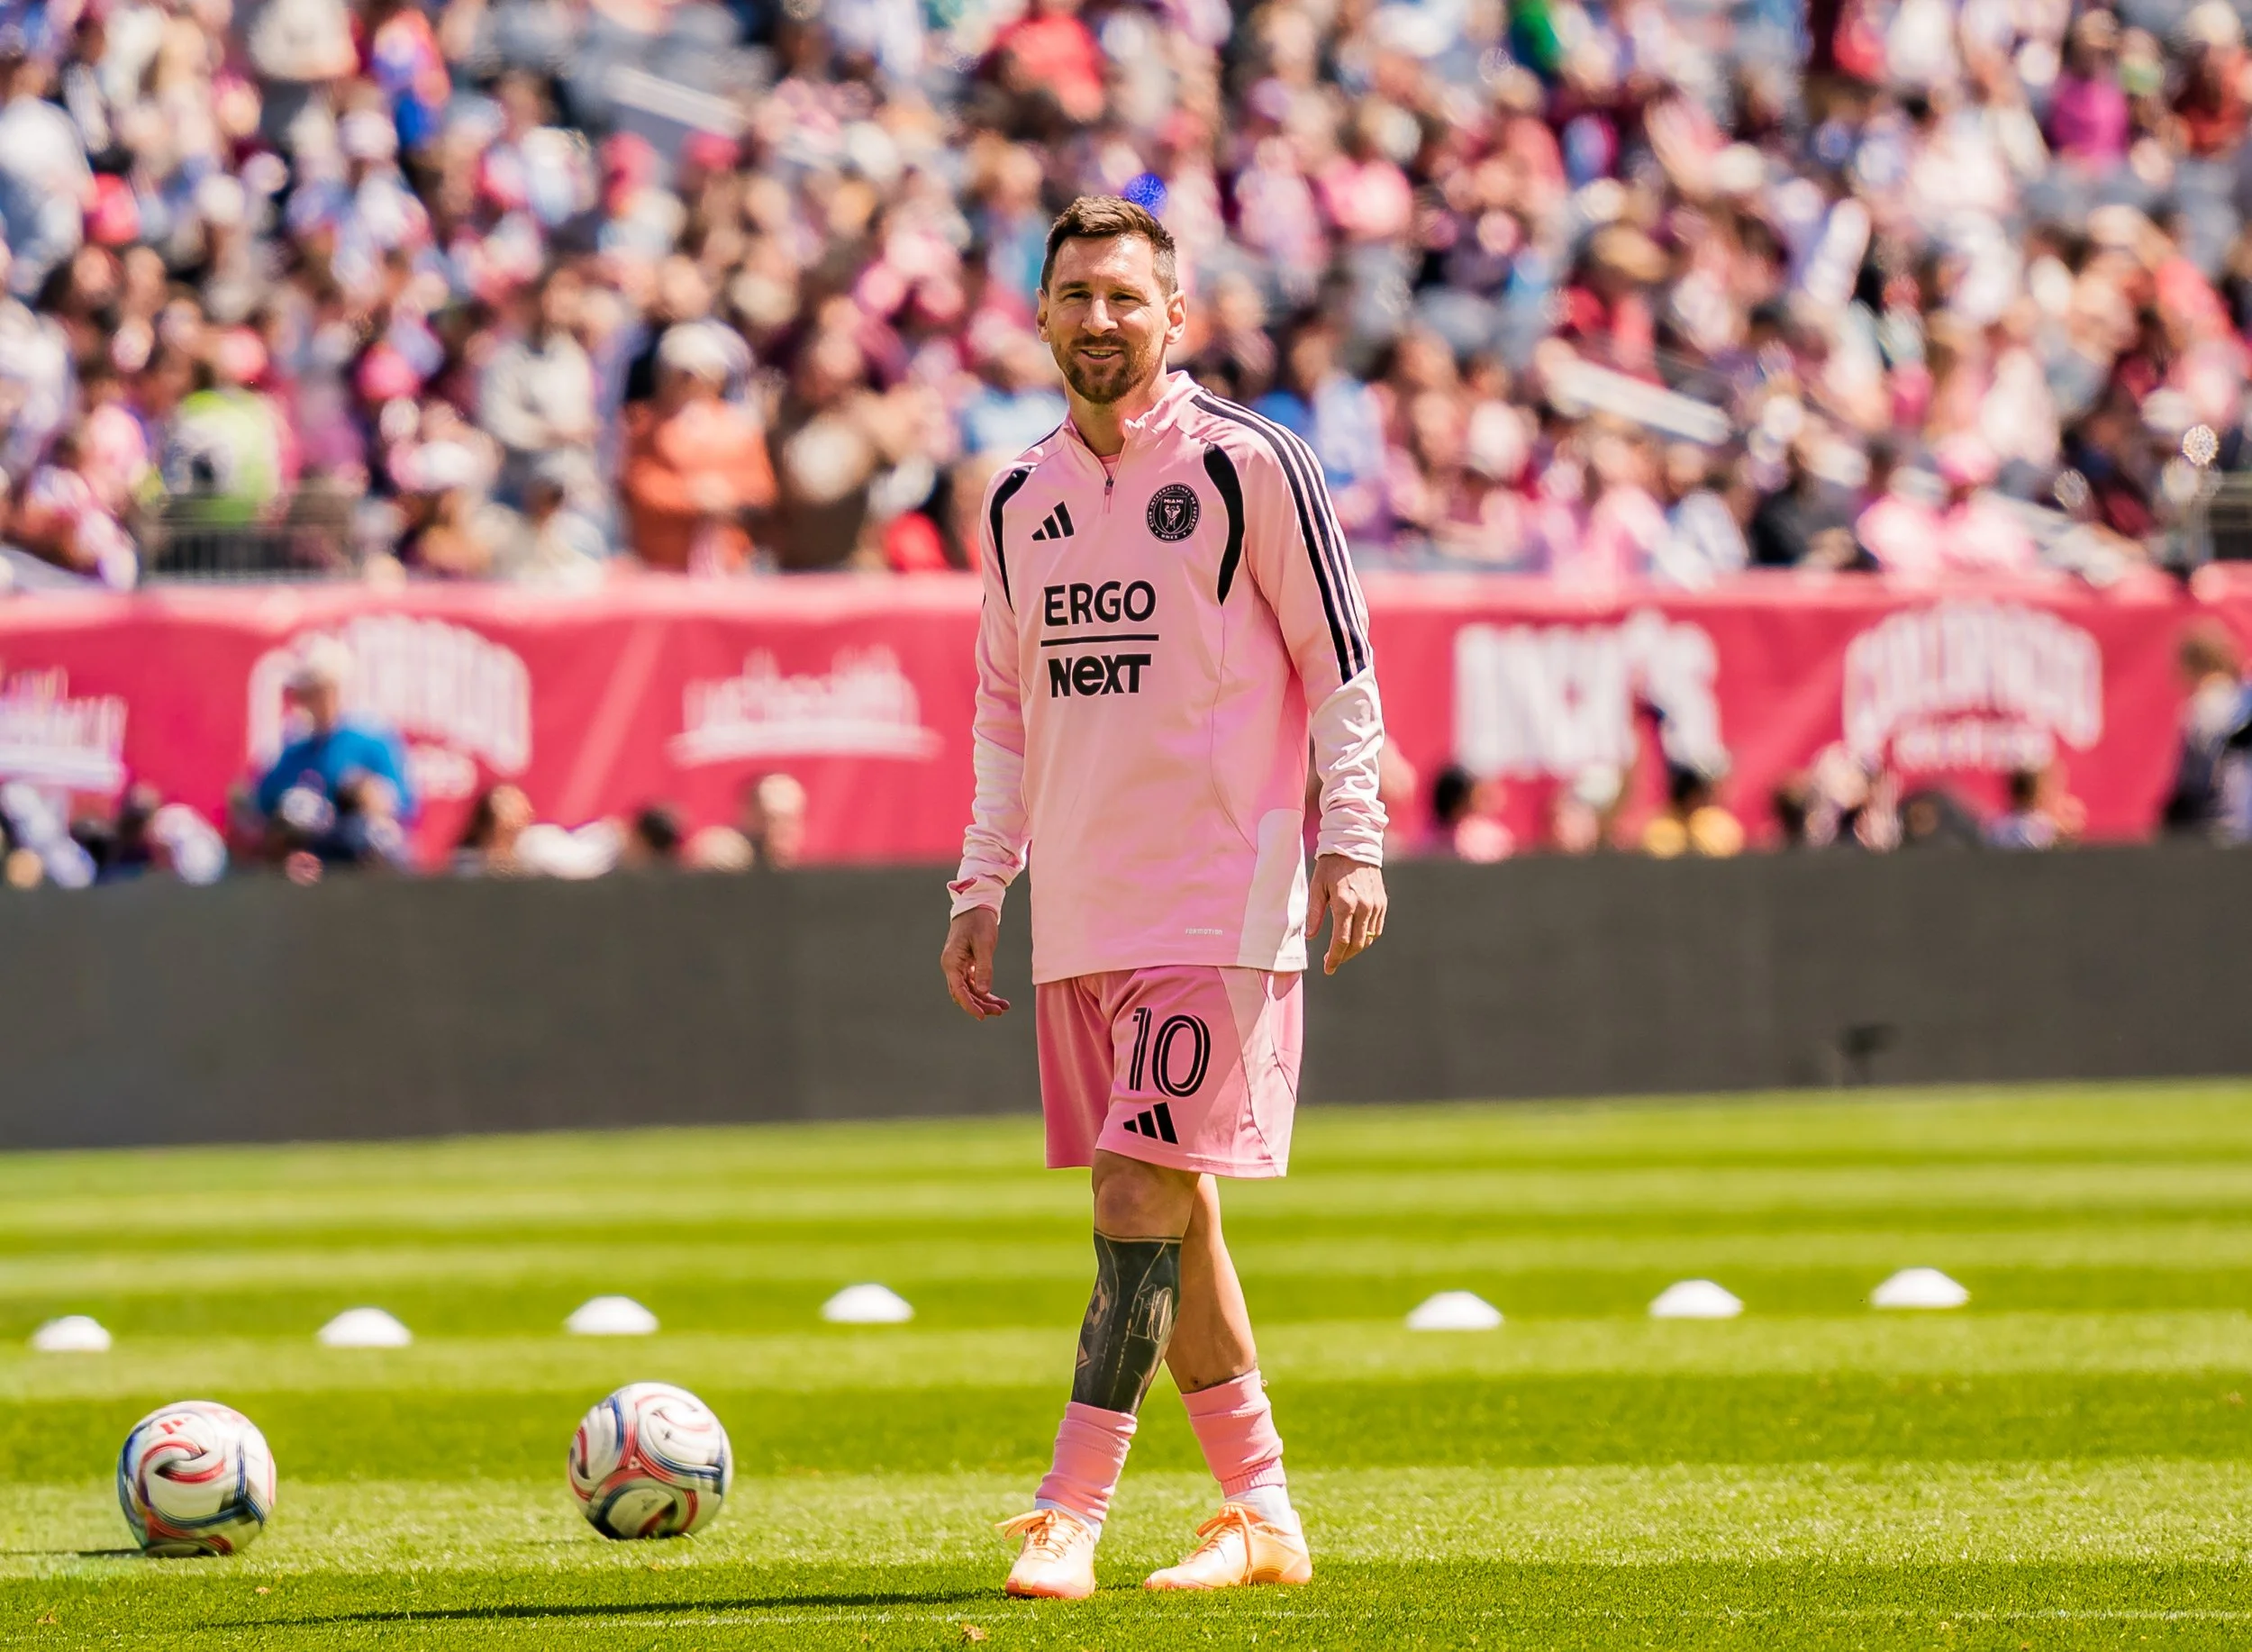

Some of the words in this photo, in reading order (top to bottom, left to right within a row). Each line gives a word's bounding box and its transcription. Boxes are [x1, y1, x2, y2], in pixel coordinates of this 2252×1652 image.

[1043, 579, 1157, 627] ERGO
[1128, 1006, 1212, 1098] 10
[1131, 1283, 1174, 1344] 10
